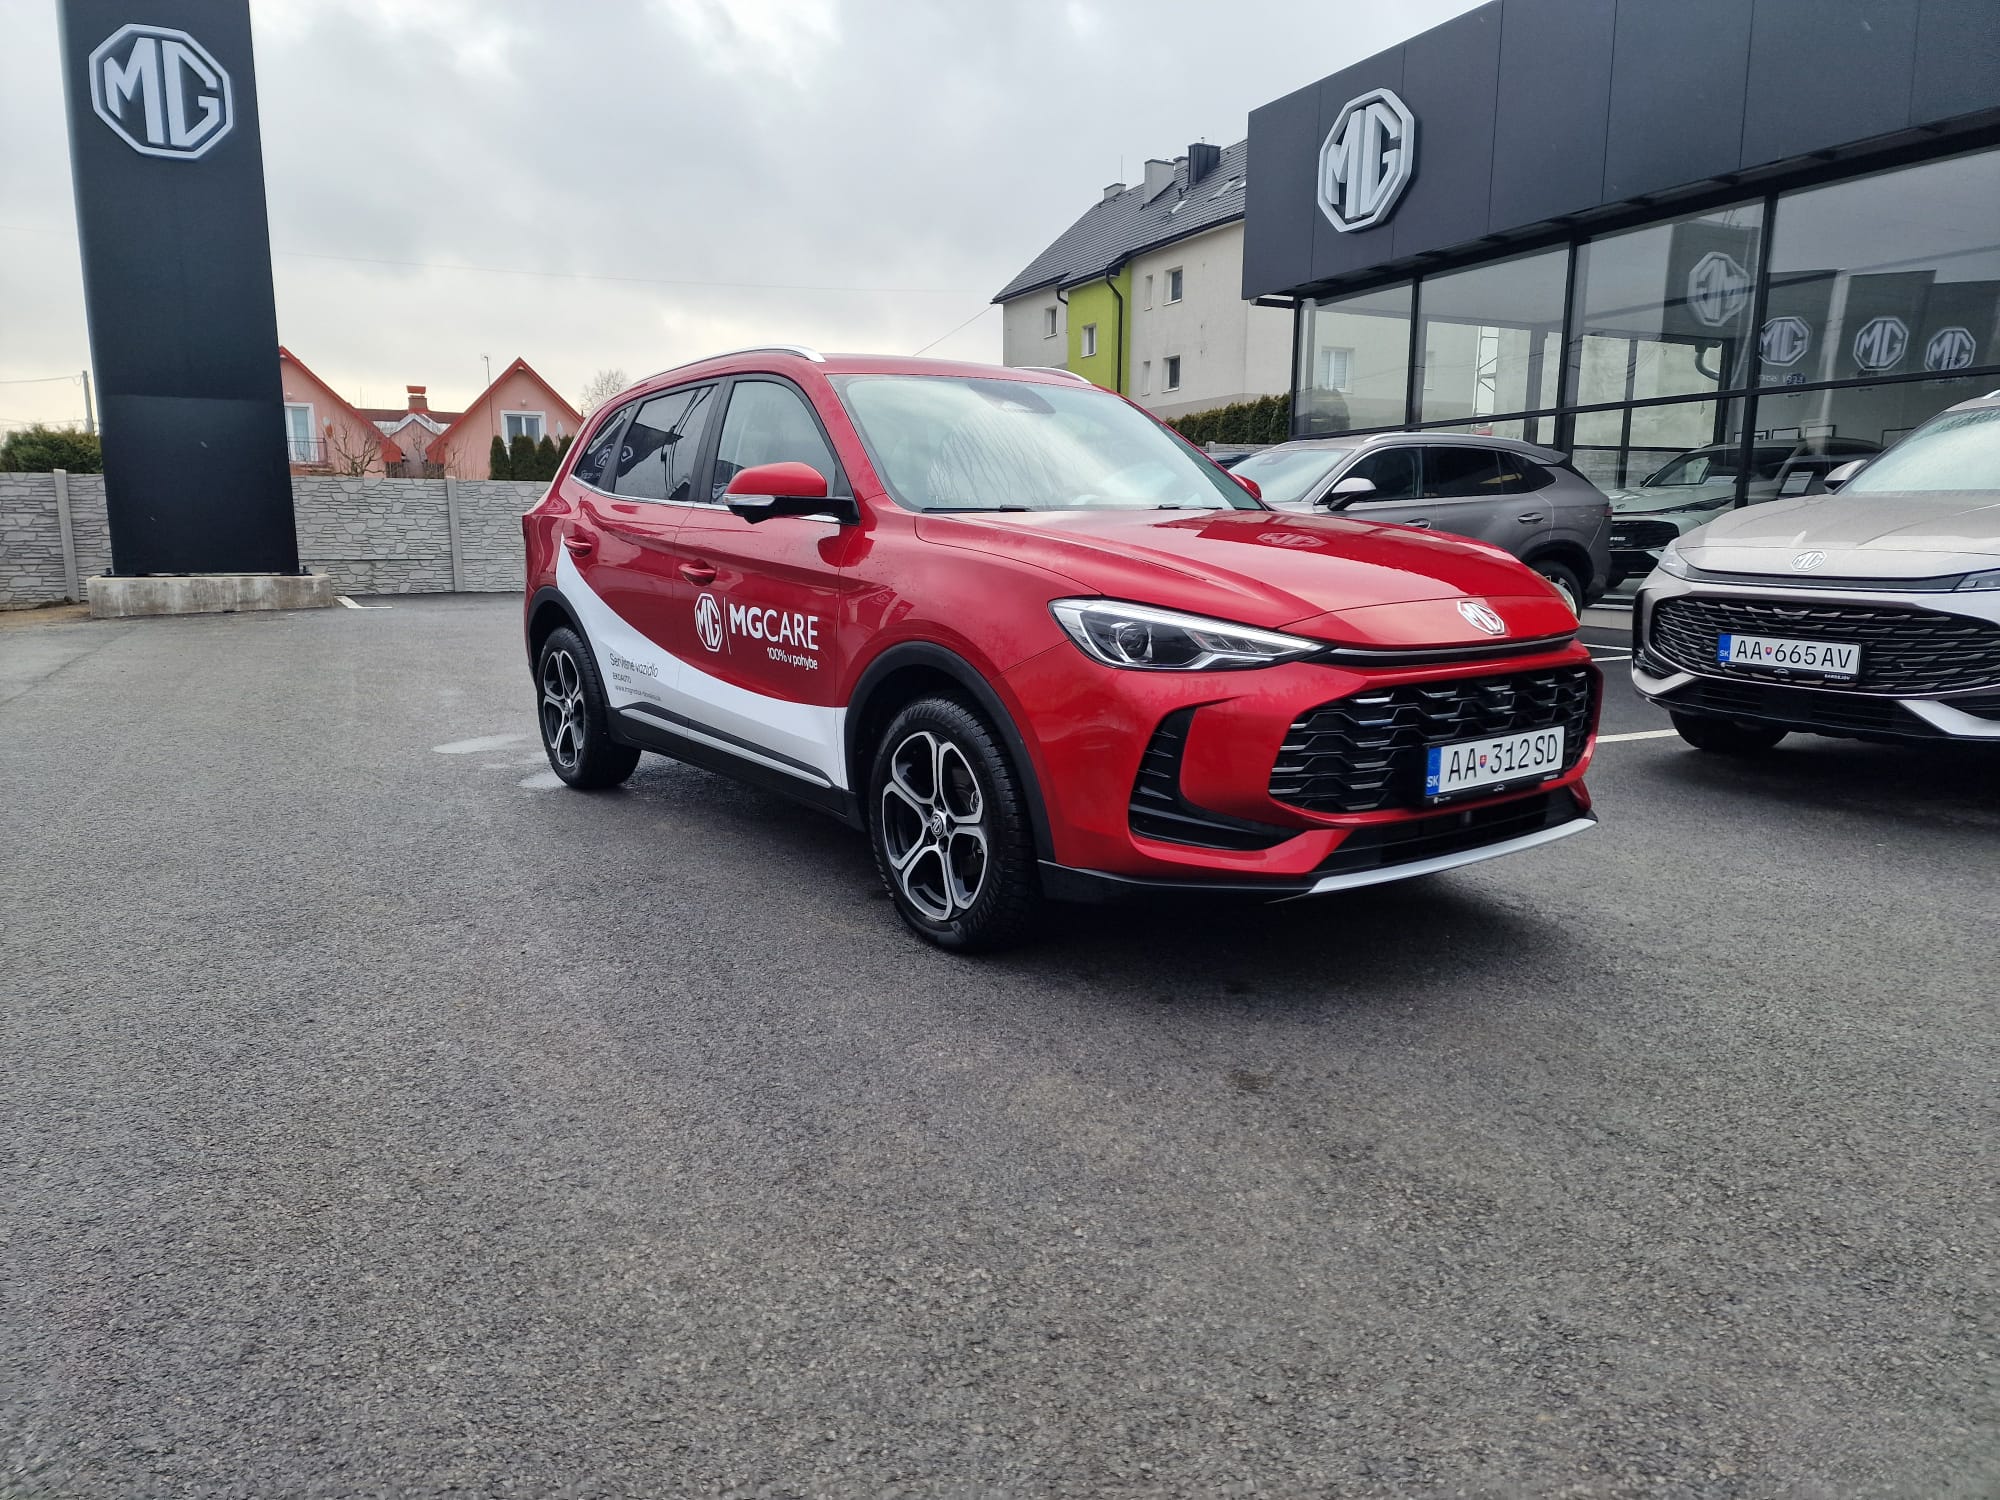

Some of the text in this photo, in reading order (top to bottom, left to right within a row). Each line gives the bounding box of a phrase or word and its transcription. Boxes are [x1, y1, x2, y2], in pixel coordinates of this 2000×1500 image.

[102, 35, 222, 149] MG
[1323, 100, 1405, 221] MG
[1760, 320, 1807, 362] MG
[1857, 320, 1904, 368] MG
[1927, 331, 1972, 370] MG
[1791, 551, 1825, 570] MG
[696, 597, 720, 649] MG
[729, 603, 819, 650] MGCARE
[1461, 602, 1503, 633] MG
[635, 662, 659, 677] vozidlo
[767, 647, 787, 662] 100%
[792, 655, 818, 670] pohybe
[1736, 640, 1762, 660] AA
[1427, 774, 1440, 788] SK
[1448, 747, 1477, 783] AA
